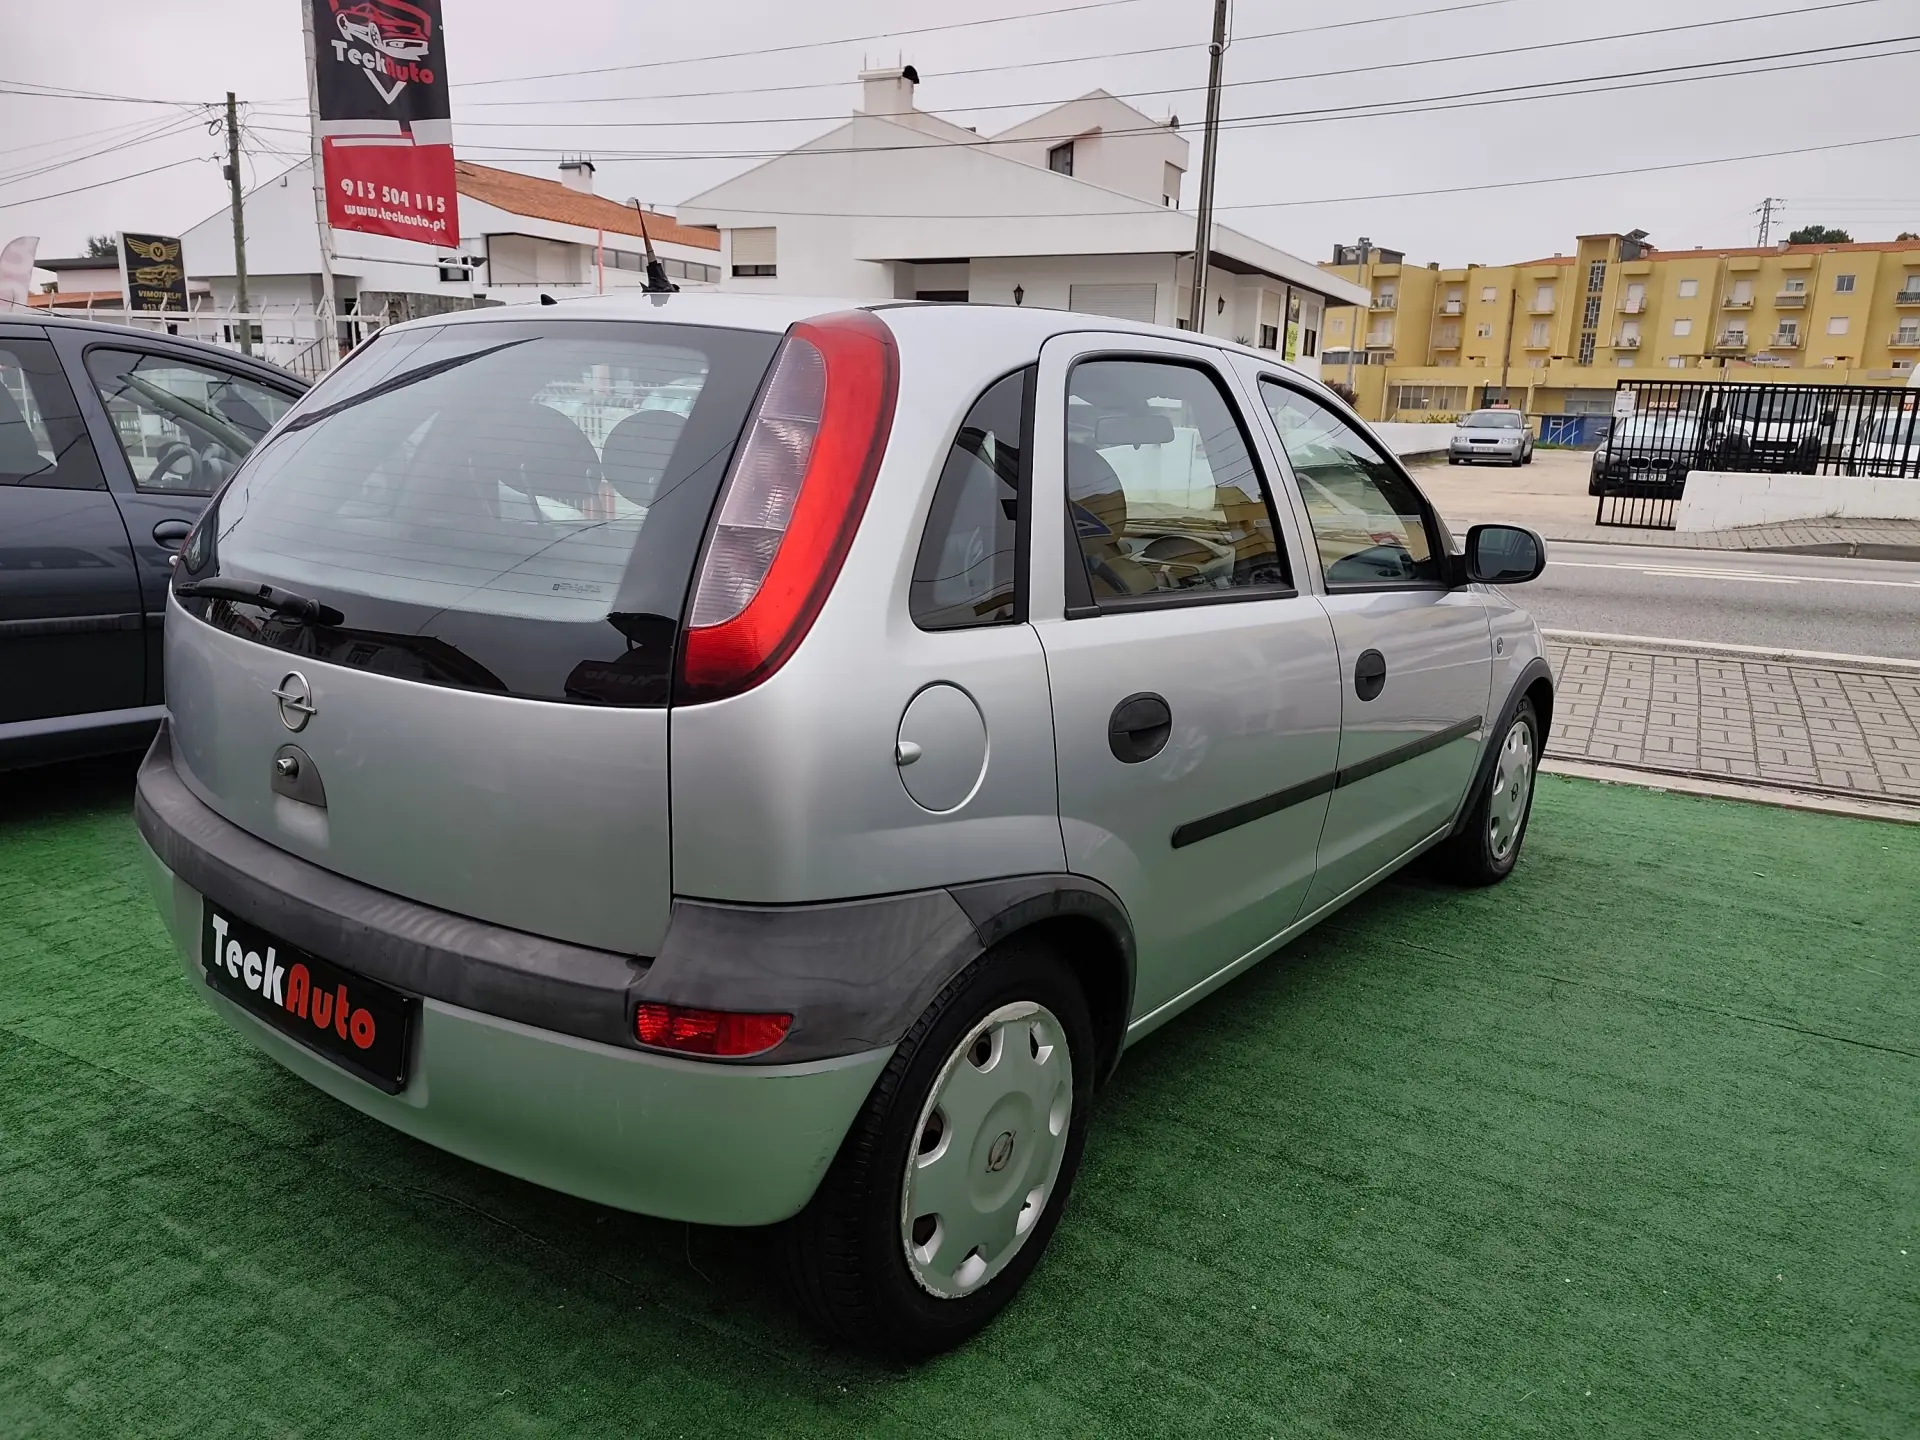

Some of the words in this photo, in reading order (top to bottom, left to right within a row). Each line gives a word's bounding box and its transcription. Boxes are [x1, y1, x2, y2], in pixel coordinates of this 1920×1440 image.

[331, 39, 434, 84] TeckAuto
[341, 178, 376, 200] 913
[382, 185, 410, 208] 504
[416, 193, 446, 213] 115
[344, 204, 446, 232] www.teckauto.pt
[212, 913, 376, 1049] TeckAuto
